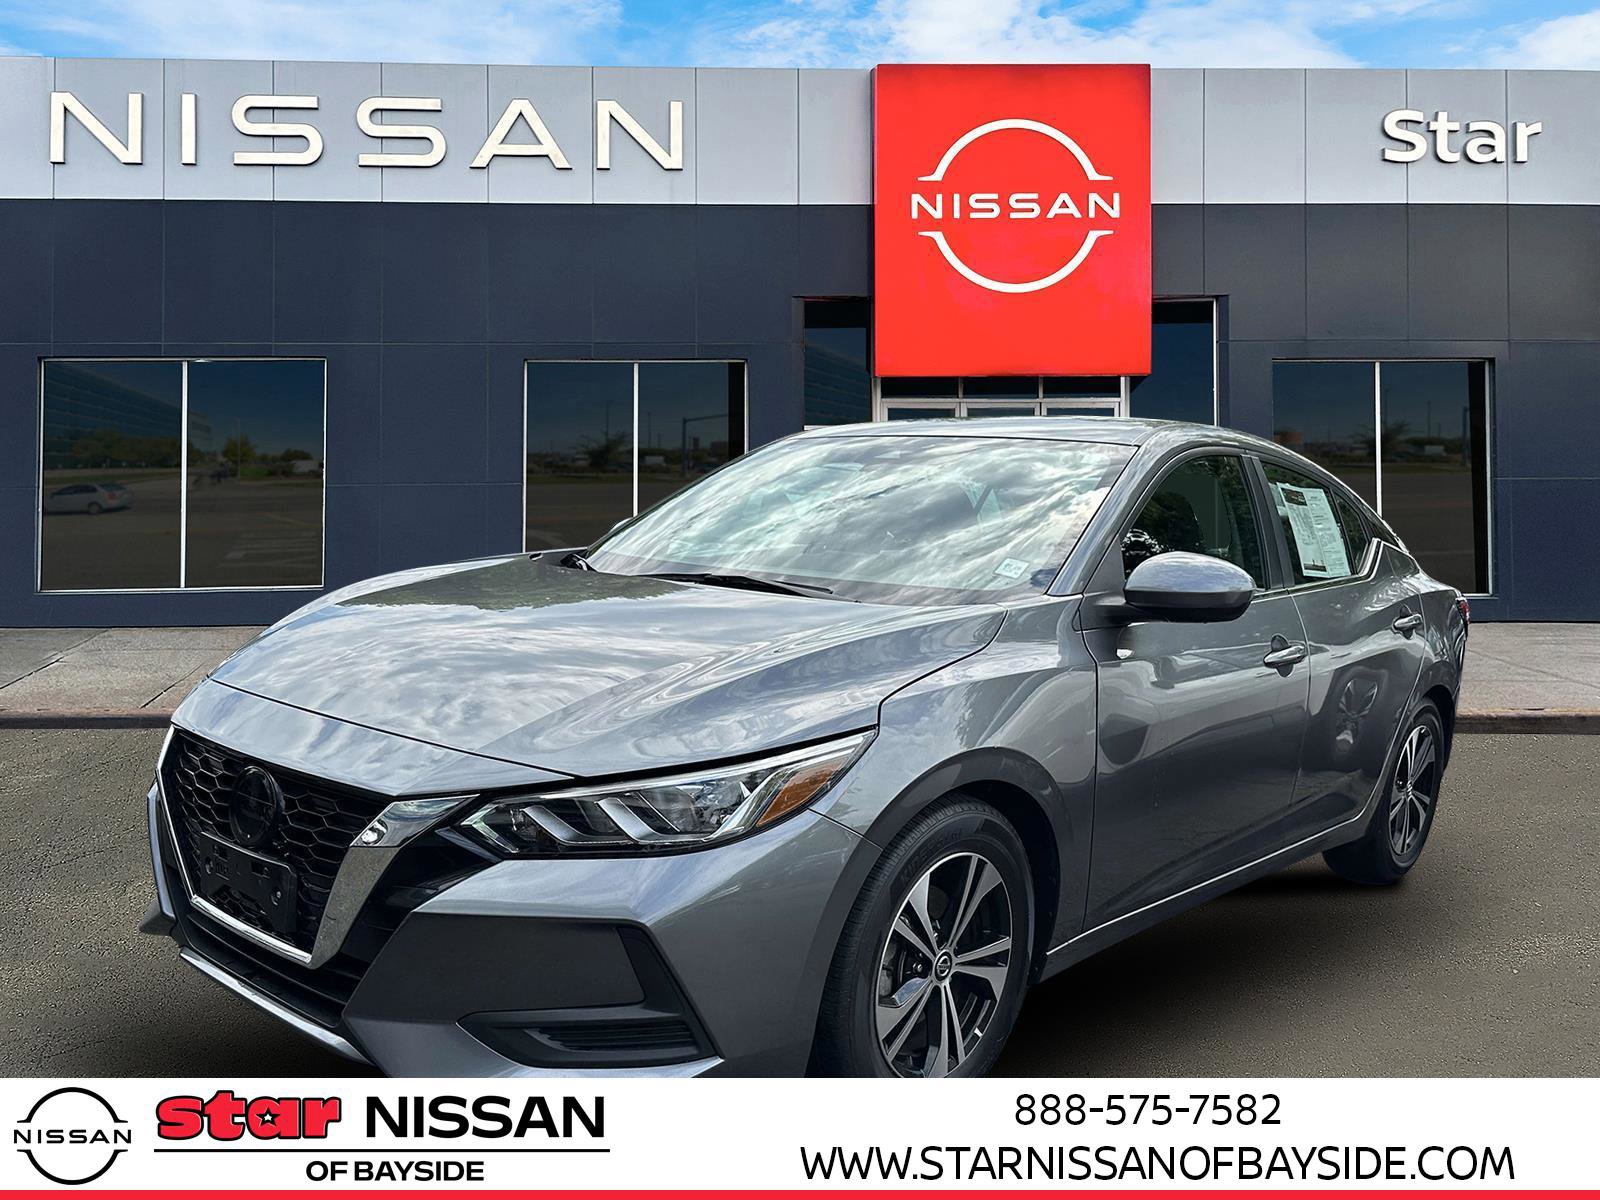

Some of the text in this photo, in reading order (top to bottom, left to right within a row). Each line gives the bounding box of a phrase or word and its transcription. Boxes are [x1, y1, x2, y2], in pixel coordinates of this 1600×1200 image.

[50, 91, 684, 170] NISSAN
[1381, 108, 1543, 164] Star
[910, 191, 1121, 220] NISSAN
